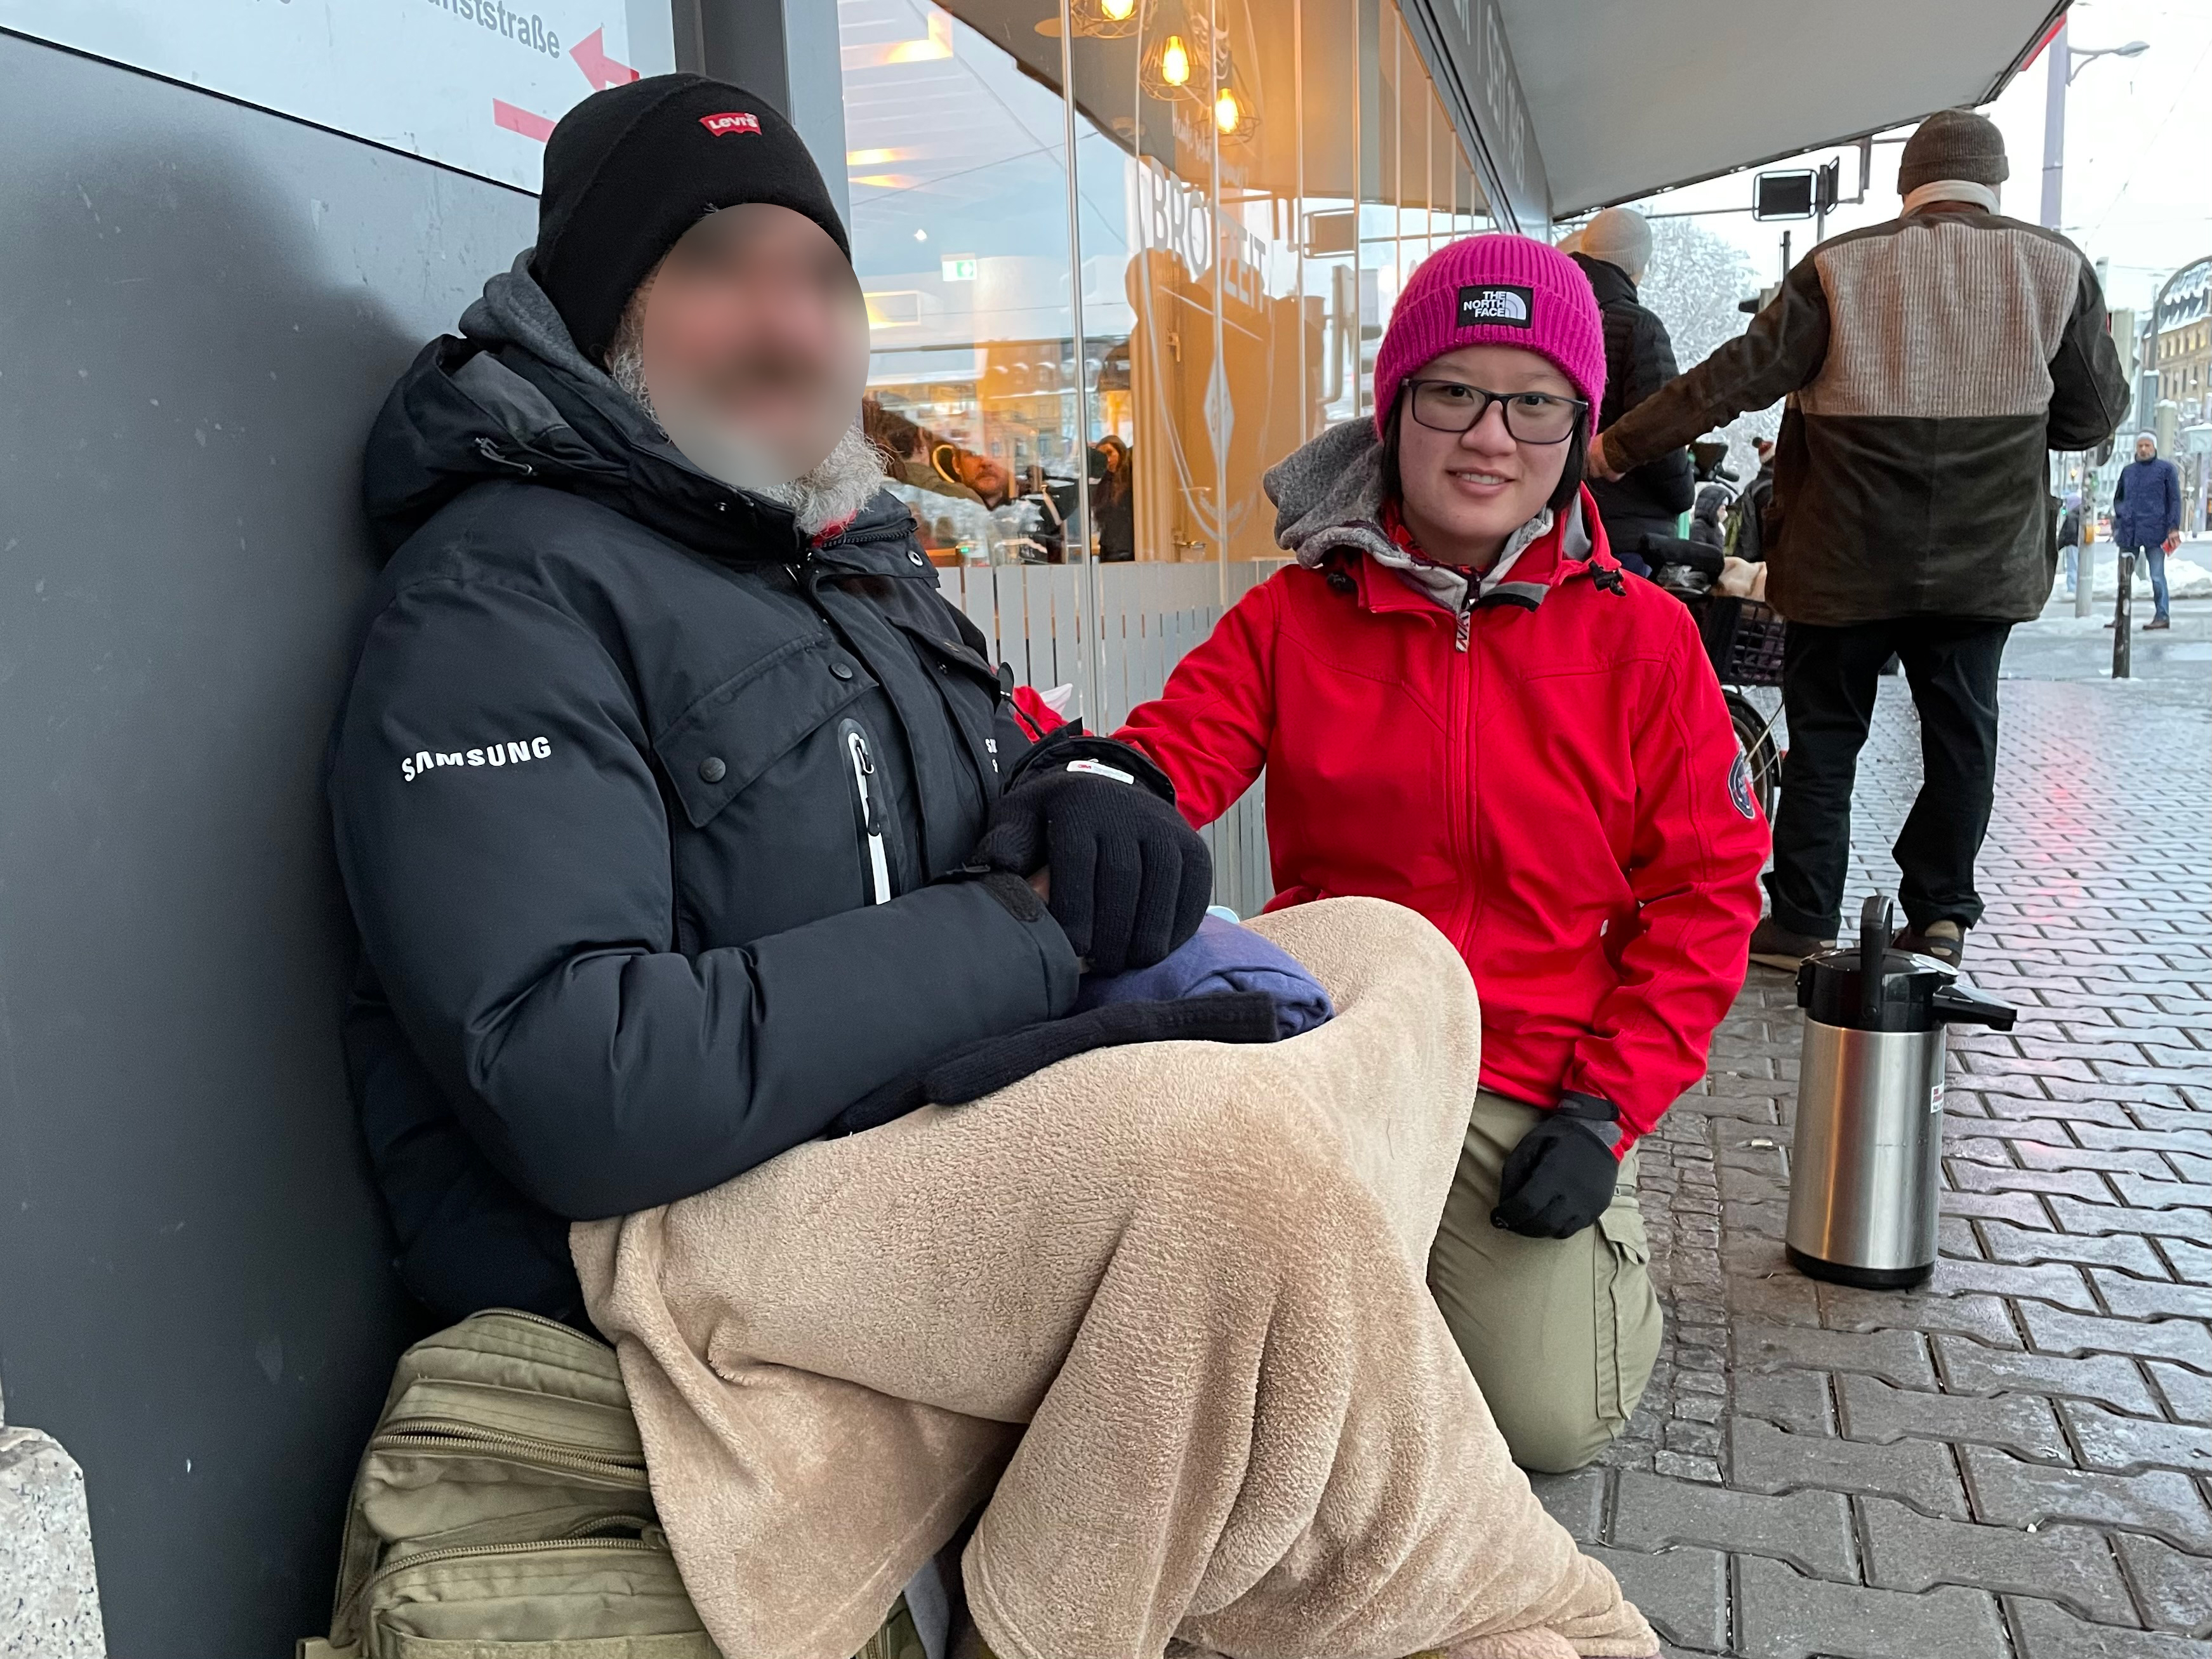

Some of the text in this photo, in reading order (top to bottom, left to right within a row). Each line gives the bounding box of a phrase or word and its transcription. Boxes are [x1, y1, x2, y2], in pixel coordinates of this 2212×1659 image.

[428, 0, 559, 58] ststraße
[1151, 156, 1266, 314] BROZEIT
[1463, 298, 1505, 311] NORTH
[1483, 291, 1506, 300] THE
[1474, 308, 1505, 317] FACE
[402, 737, 551, 781] SAMSUNG
